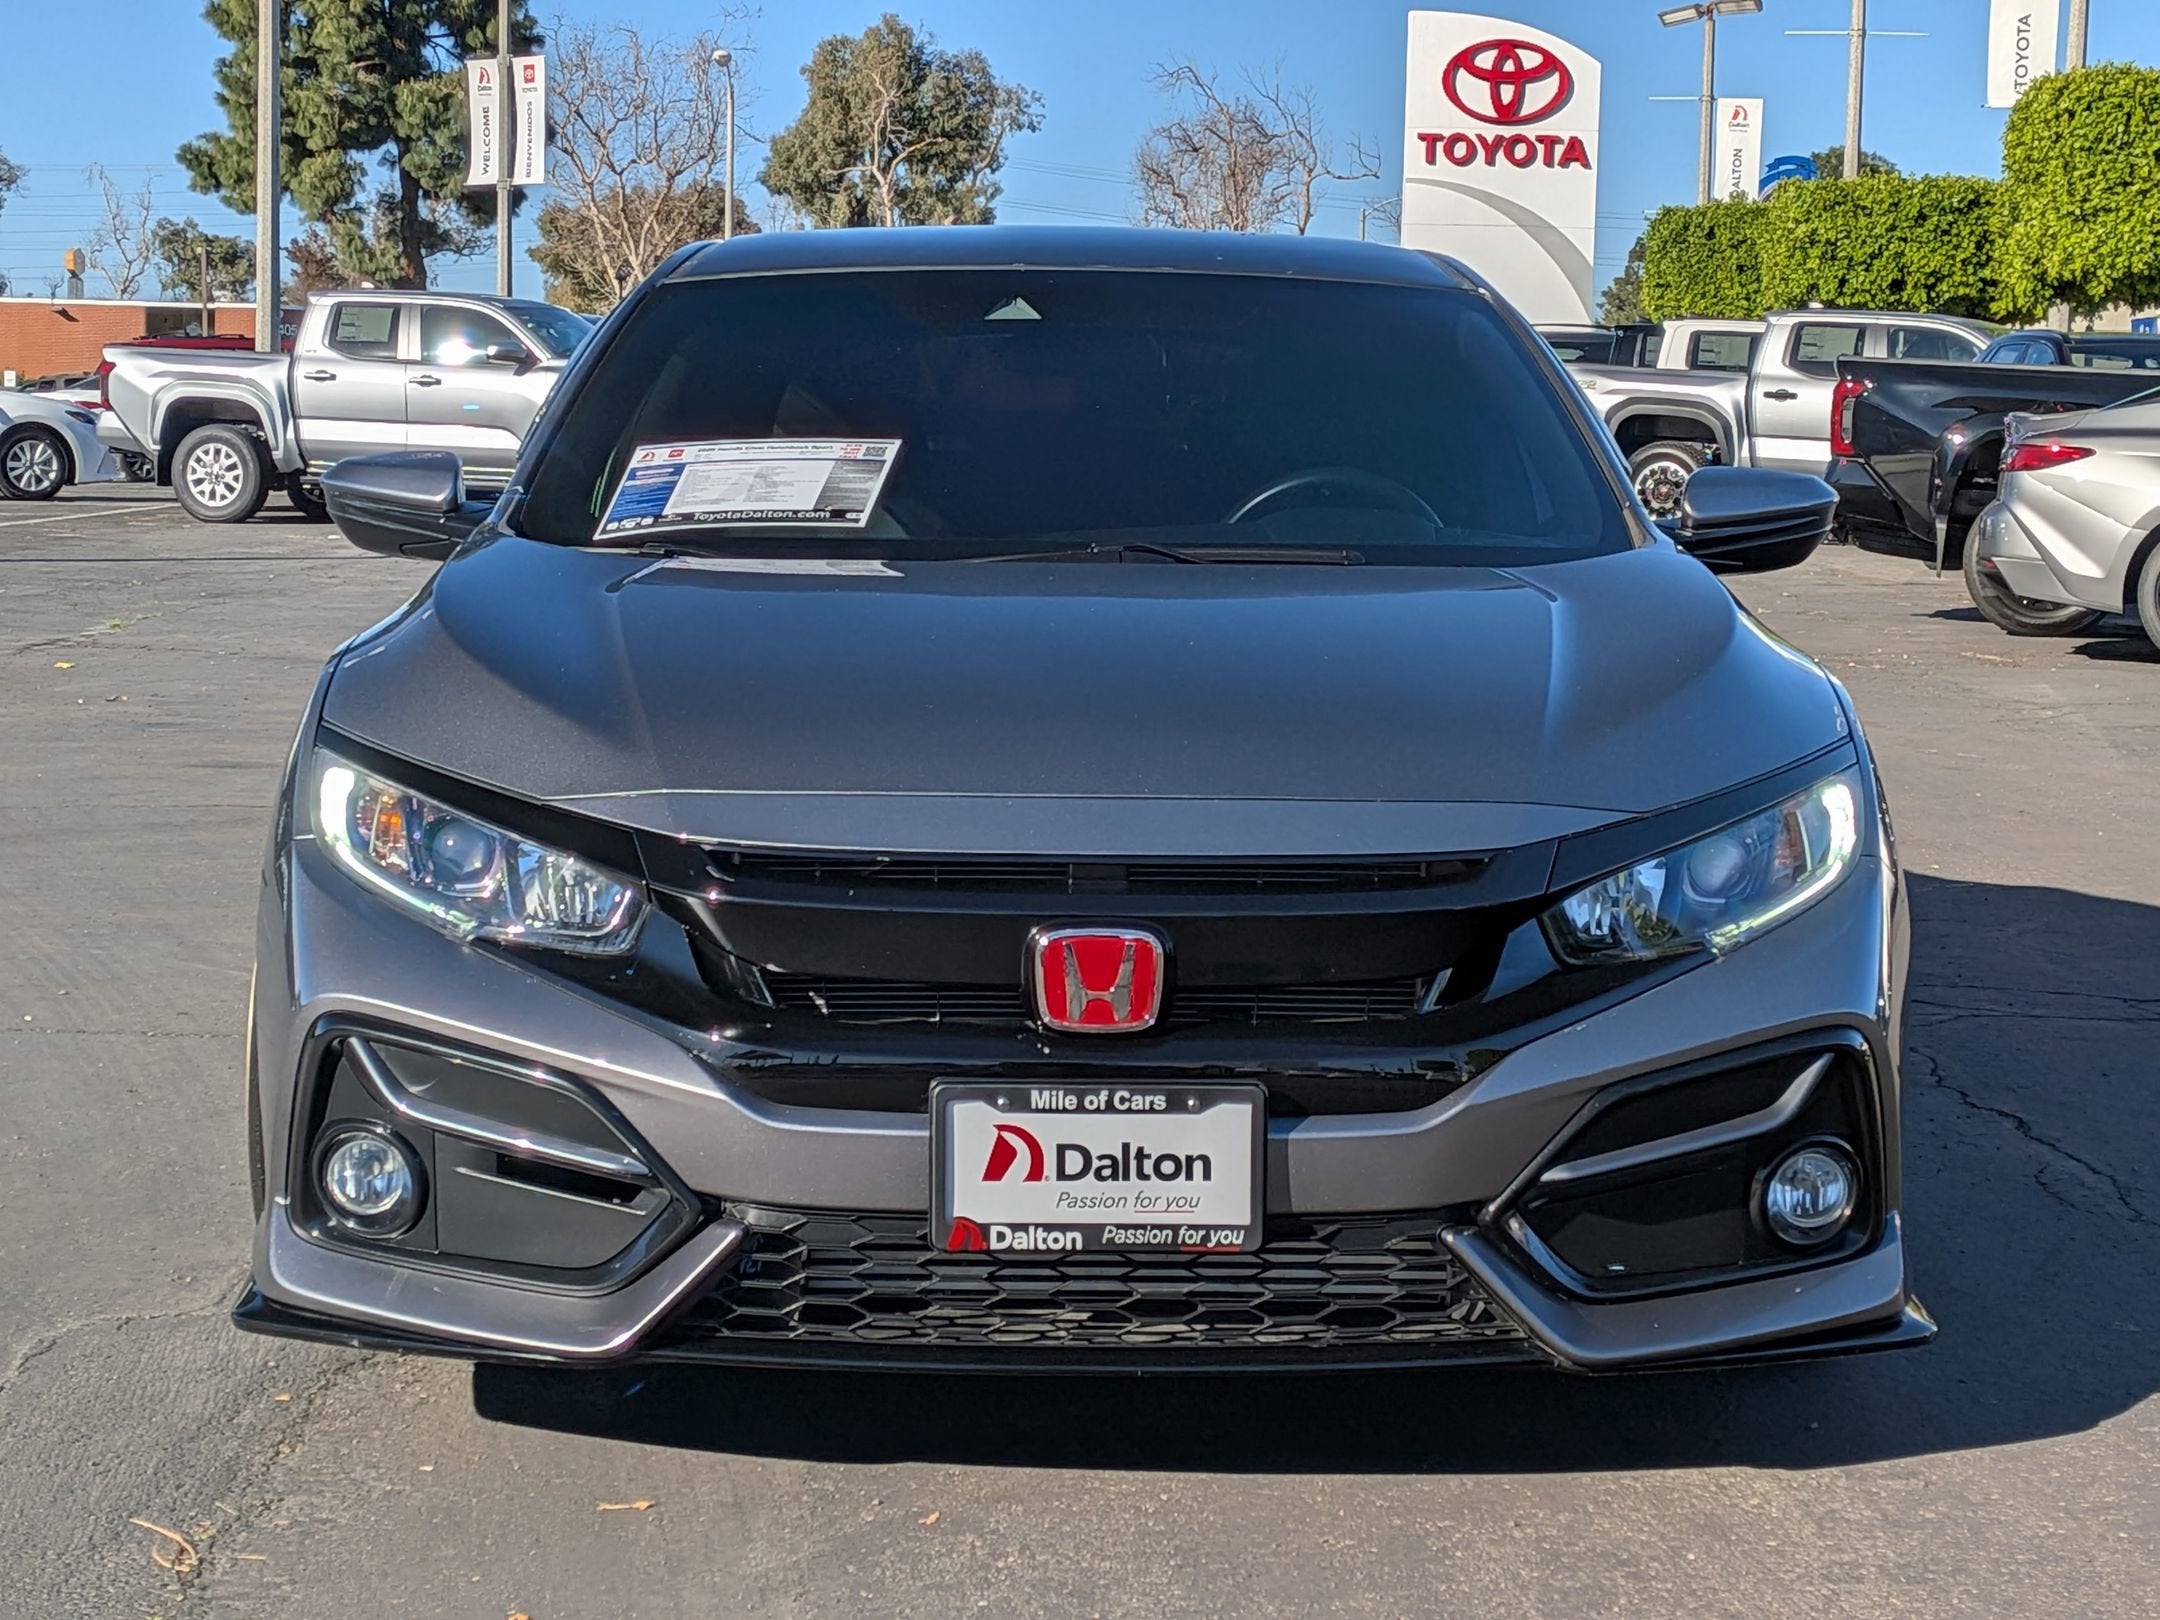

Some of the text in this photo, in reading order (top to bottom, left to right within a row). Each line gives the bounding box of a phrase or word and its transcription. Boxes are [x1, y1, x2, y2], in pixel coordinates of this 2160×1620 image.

[2014, 13, 2032, 90] TOYOTA
[481, 106, 491, 176] WELCOME
[525, 101, 533, 178] BIENVENIDOS
[1417, 132, 1592, 169] TOYOTA
[693, 510, 831, 522] ToyotaDalton.com
[1031, 1089, 1168, 1111] Mile of Cars
[1055, 1142, 1212, 1182] Dalton
[1056, 1190, 1201, 1213] Passion for you
[989, 1225, 1245, 1251] Dalton Passion for you
